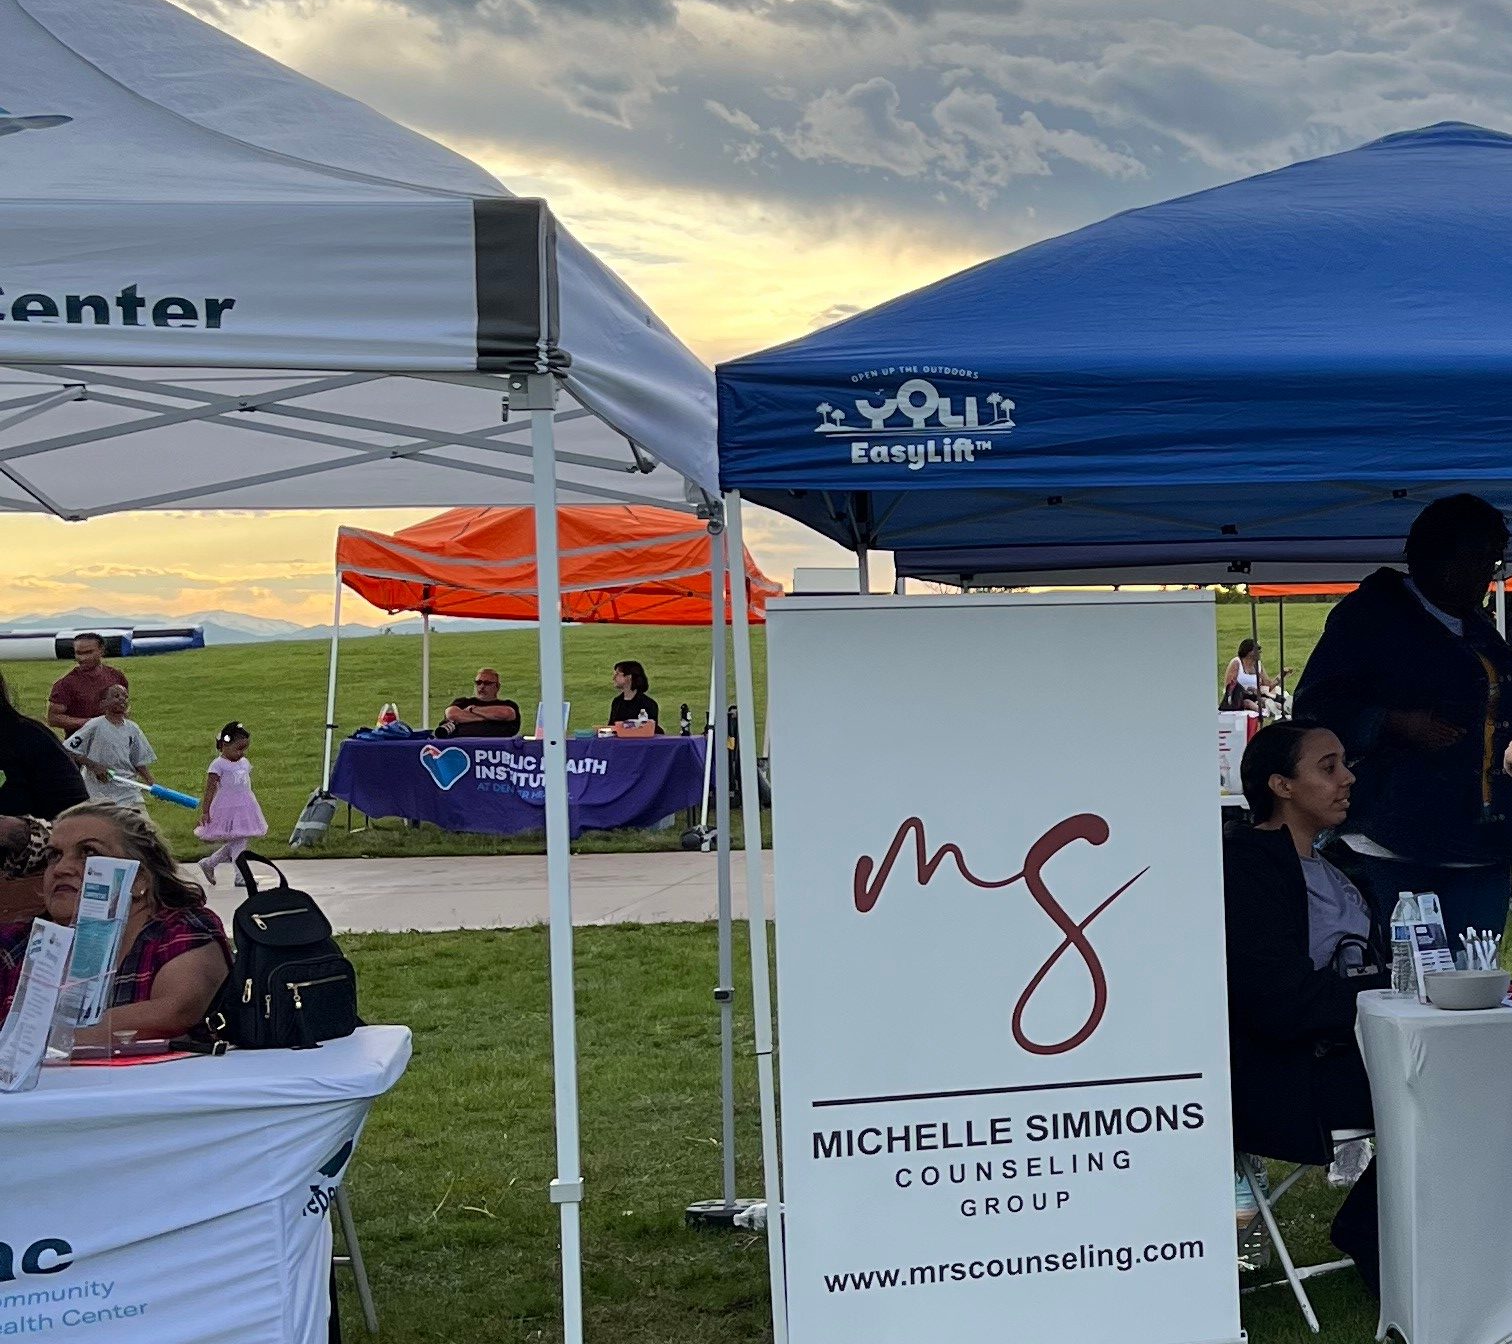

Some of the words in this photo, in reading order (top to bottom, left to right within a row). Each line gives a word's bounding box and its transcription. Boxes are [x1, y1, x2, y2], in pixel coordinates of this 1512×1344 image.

[0, 283, 236, 329] enter
[851, 370, 878, 383] OPEN
[881, 367, 895, 376] UP
[899, 365, 918, 374] THE
[922, 365, 979, 380] OUTDOORS
[475, 749, 537, 771] PUBLIC
[540, 756, 608, 775] ALTH
[812, 1116, 1014, 1160] MICHELLE
[1026, 1102, 1206, 1142] SIMMONS
[895, 1150, 1132, 1188] COUNSELING
[960, 1190, 1071, 1217] GROUP
[824, 1239, 1206, 1293] www.mrscounseling.com
[0, 1281, 115, 1308] mmunity
[0, 1314, 53, 1335] alth
[62, 1303, 148, 1327] Center
